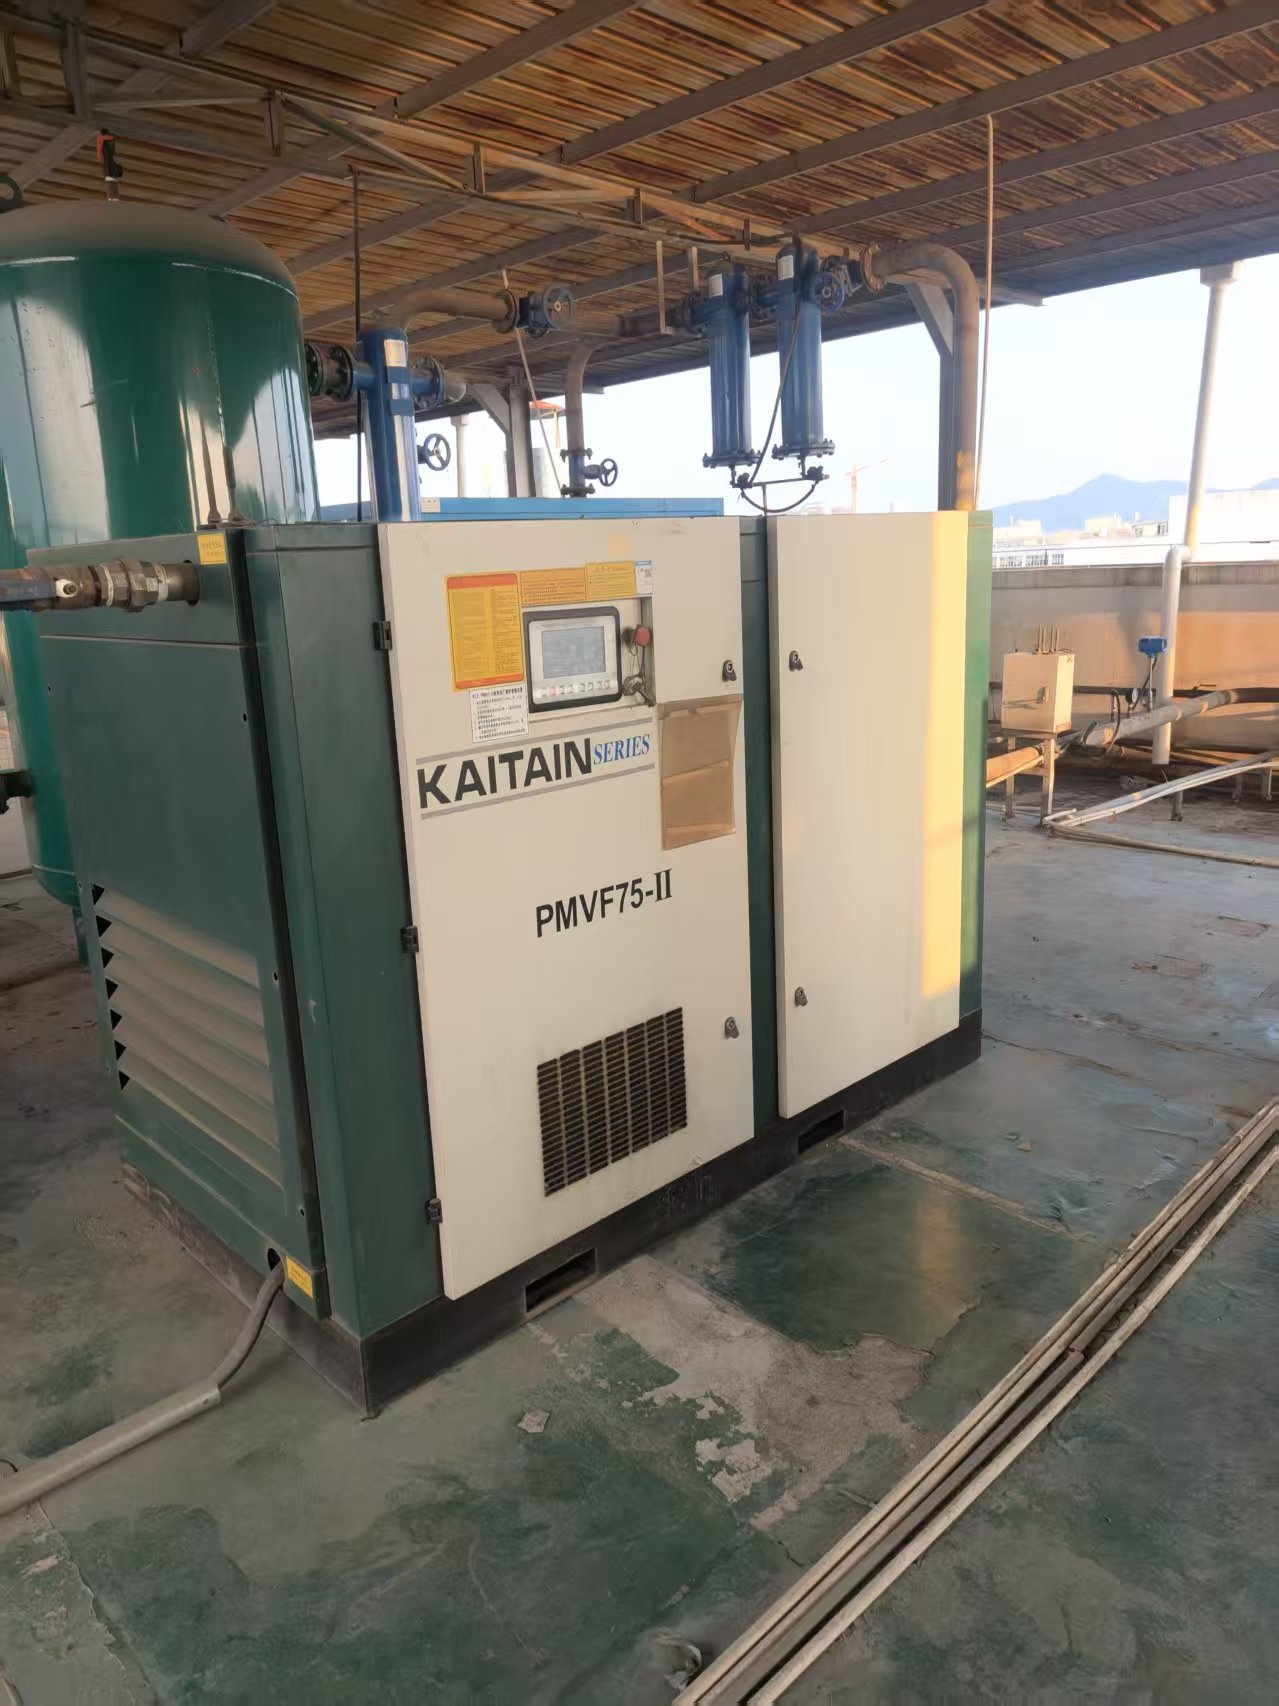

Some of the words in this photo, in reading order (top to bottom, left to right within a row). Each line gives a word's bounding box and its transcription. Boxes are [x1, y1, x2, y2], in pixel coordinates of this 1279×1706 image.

[417, 738, 592, 808] KAITAIN
[593, 734, 650, 765] SERIES
[536, 868, 672, 937] PMVF75-II
